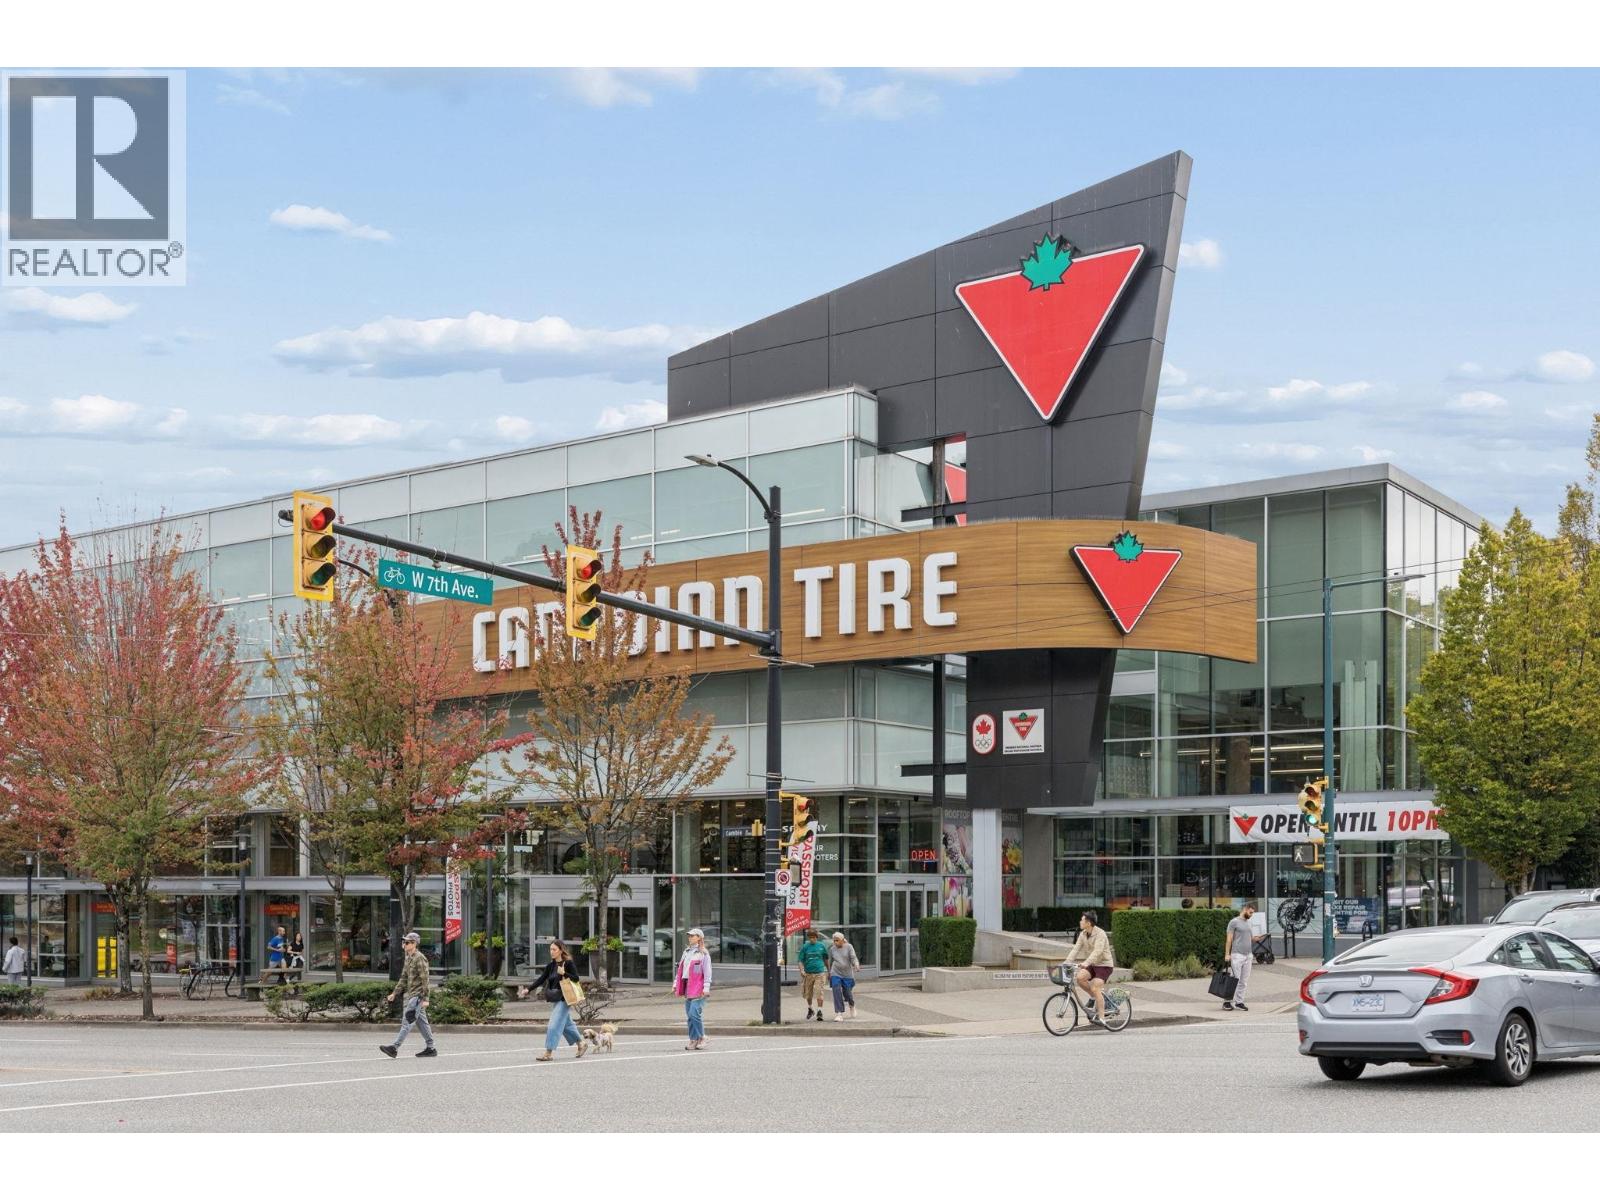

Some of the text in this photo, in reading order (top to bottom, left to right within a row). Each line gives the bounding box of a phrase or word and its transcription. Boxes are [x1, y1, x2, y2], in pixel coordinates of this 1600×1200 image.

[411, 571, 479, 599] W 7th Ave.
[793, 551, 958, 638] TIRE
[1334, 811, 1377, 832] NTIL
[911, 849, 937, 861] OPEN
